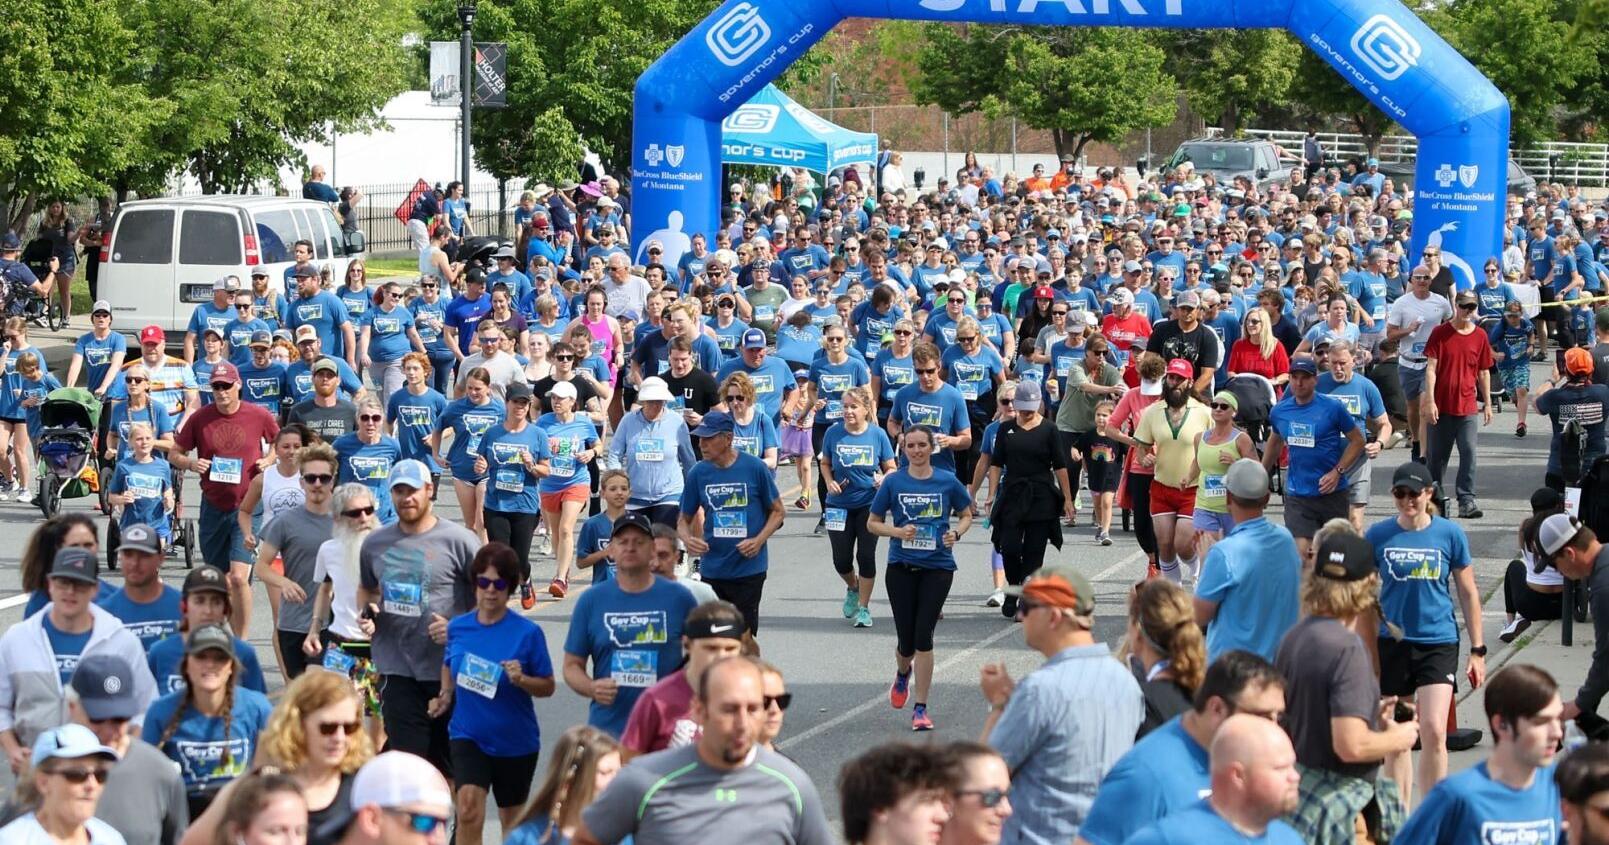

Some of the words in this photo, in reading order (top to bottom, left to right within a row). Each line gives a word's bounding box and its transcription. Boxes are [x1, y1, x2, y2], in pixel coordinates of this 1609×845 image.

[718, 45, 787, 103] governor's
[788, 23, 814, 45] cup
[479, 59, 506, 92] HOLTER
[1310, 33, 1379, 94] governor's
[1382, 96, 1406, 117] cup
[771, 149, 806, 161] cup
[661, 172, 702, 180] BlueShield
[650, 182, 684, 190] Montana
[1442, 202, 1477, 211] Montana
[684, 388, 693, 399] U
[1390, 552, 1406, 560] Gov
[1408, 552, 1425, 561] Cup
[610, 617, 629, 625] Gov
[631, 616, 648, 624] Cup
[144, 626, 163, 635] Cup
[622, 674, 645, 682] 1669
[185, 747, 206, 757] Gov
[1492, 829, 1517, 842] Gov
[1518, 829, 1539, 844] Cup
